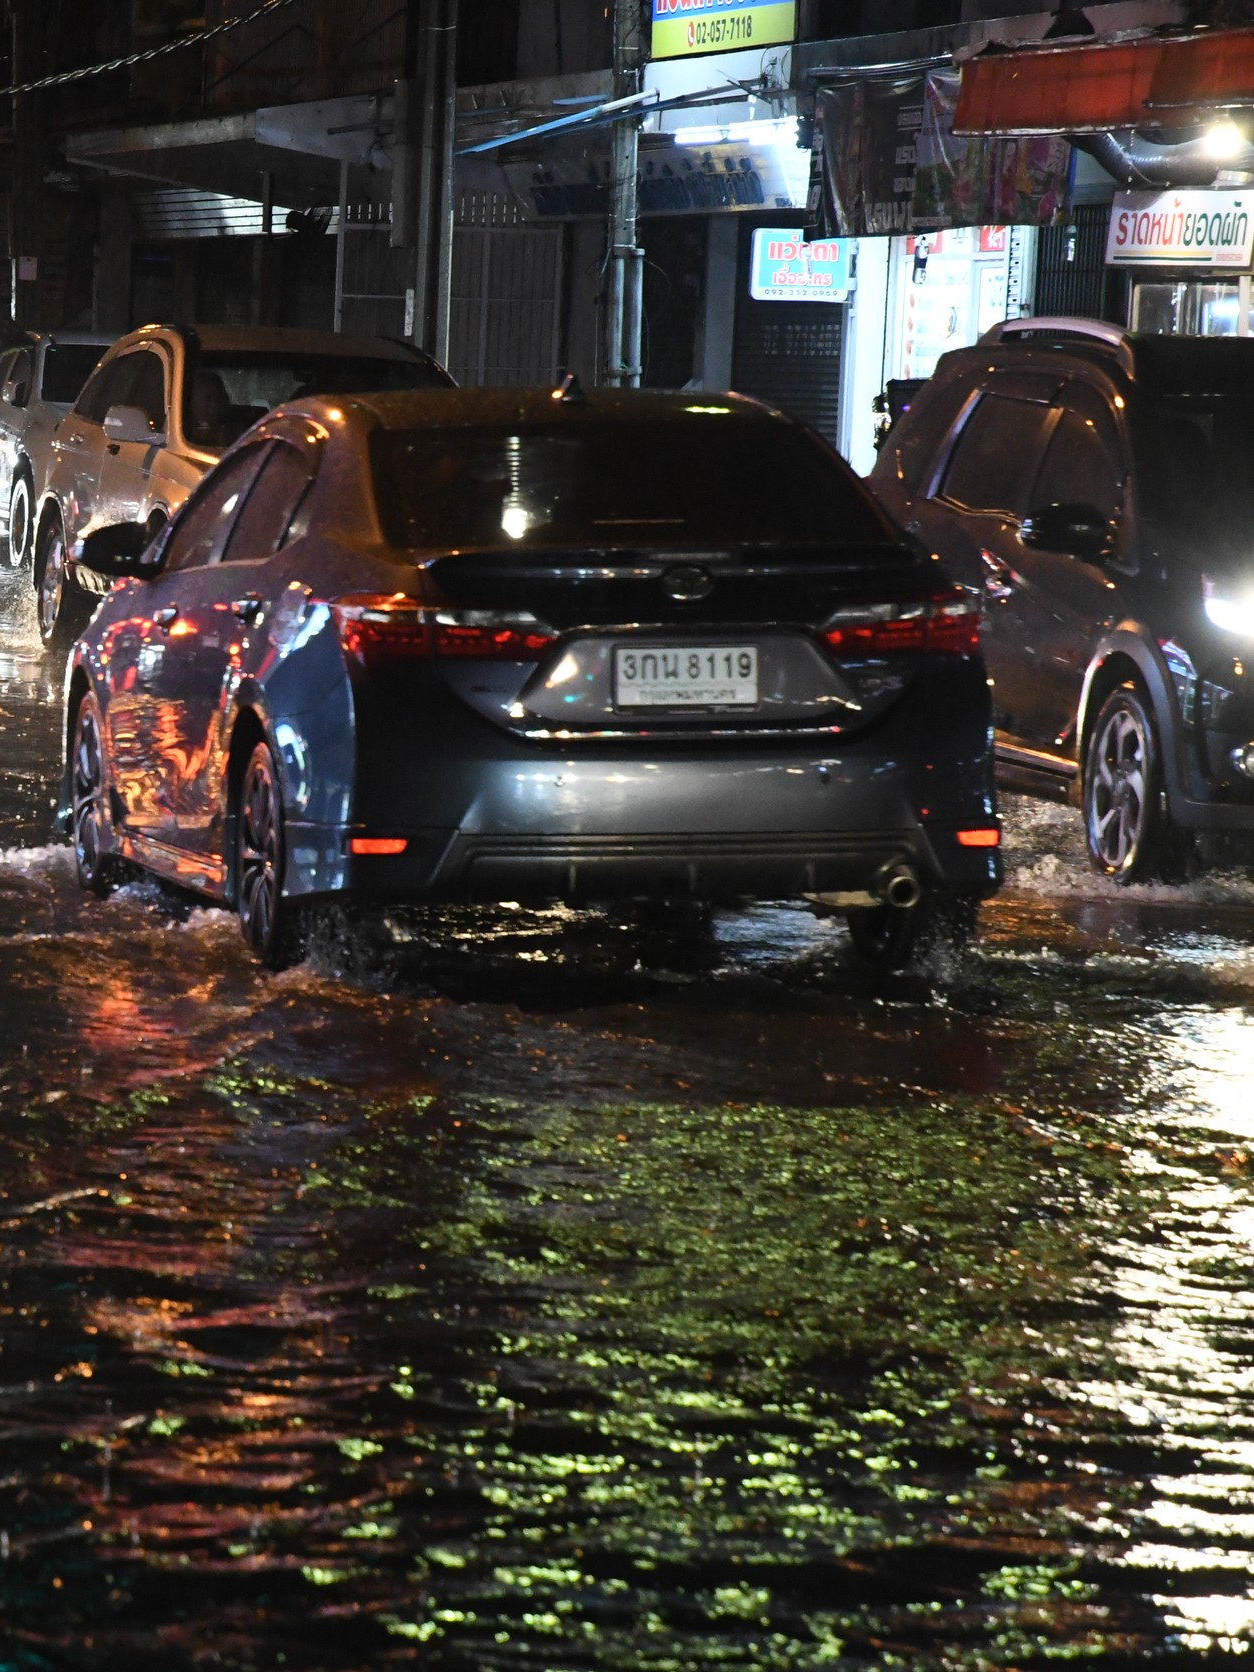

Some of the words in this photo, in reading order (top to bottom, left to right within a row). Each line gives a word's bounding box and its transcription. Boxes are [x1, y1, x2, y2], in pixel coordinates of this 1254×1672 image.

[696, 15, 752, 44] 02-057-7118
[1116, 198, 1249, 247] ราดหน้ายอดผัก
[624, 653, 678, 680] 3กน
[688, 652, 752, 679] 8119
